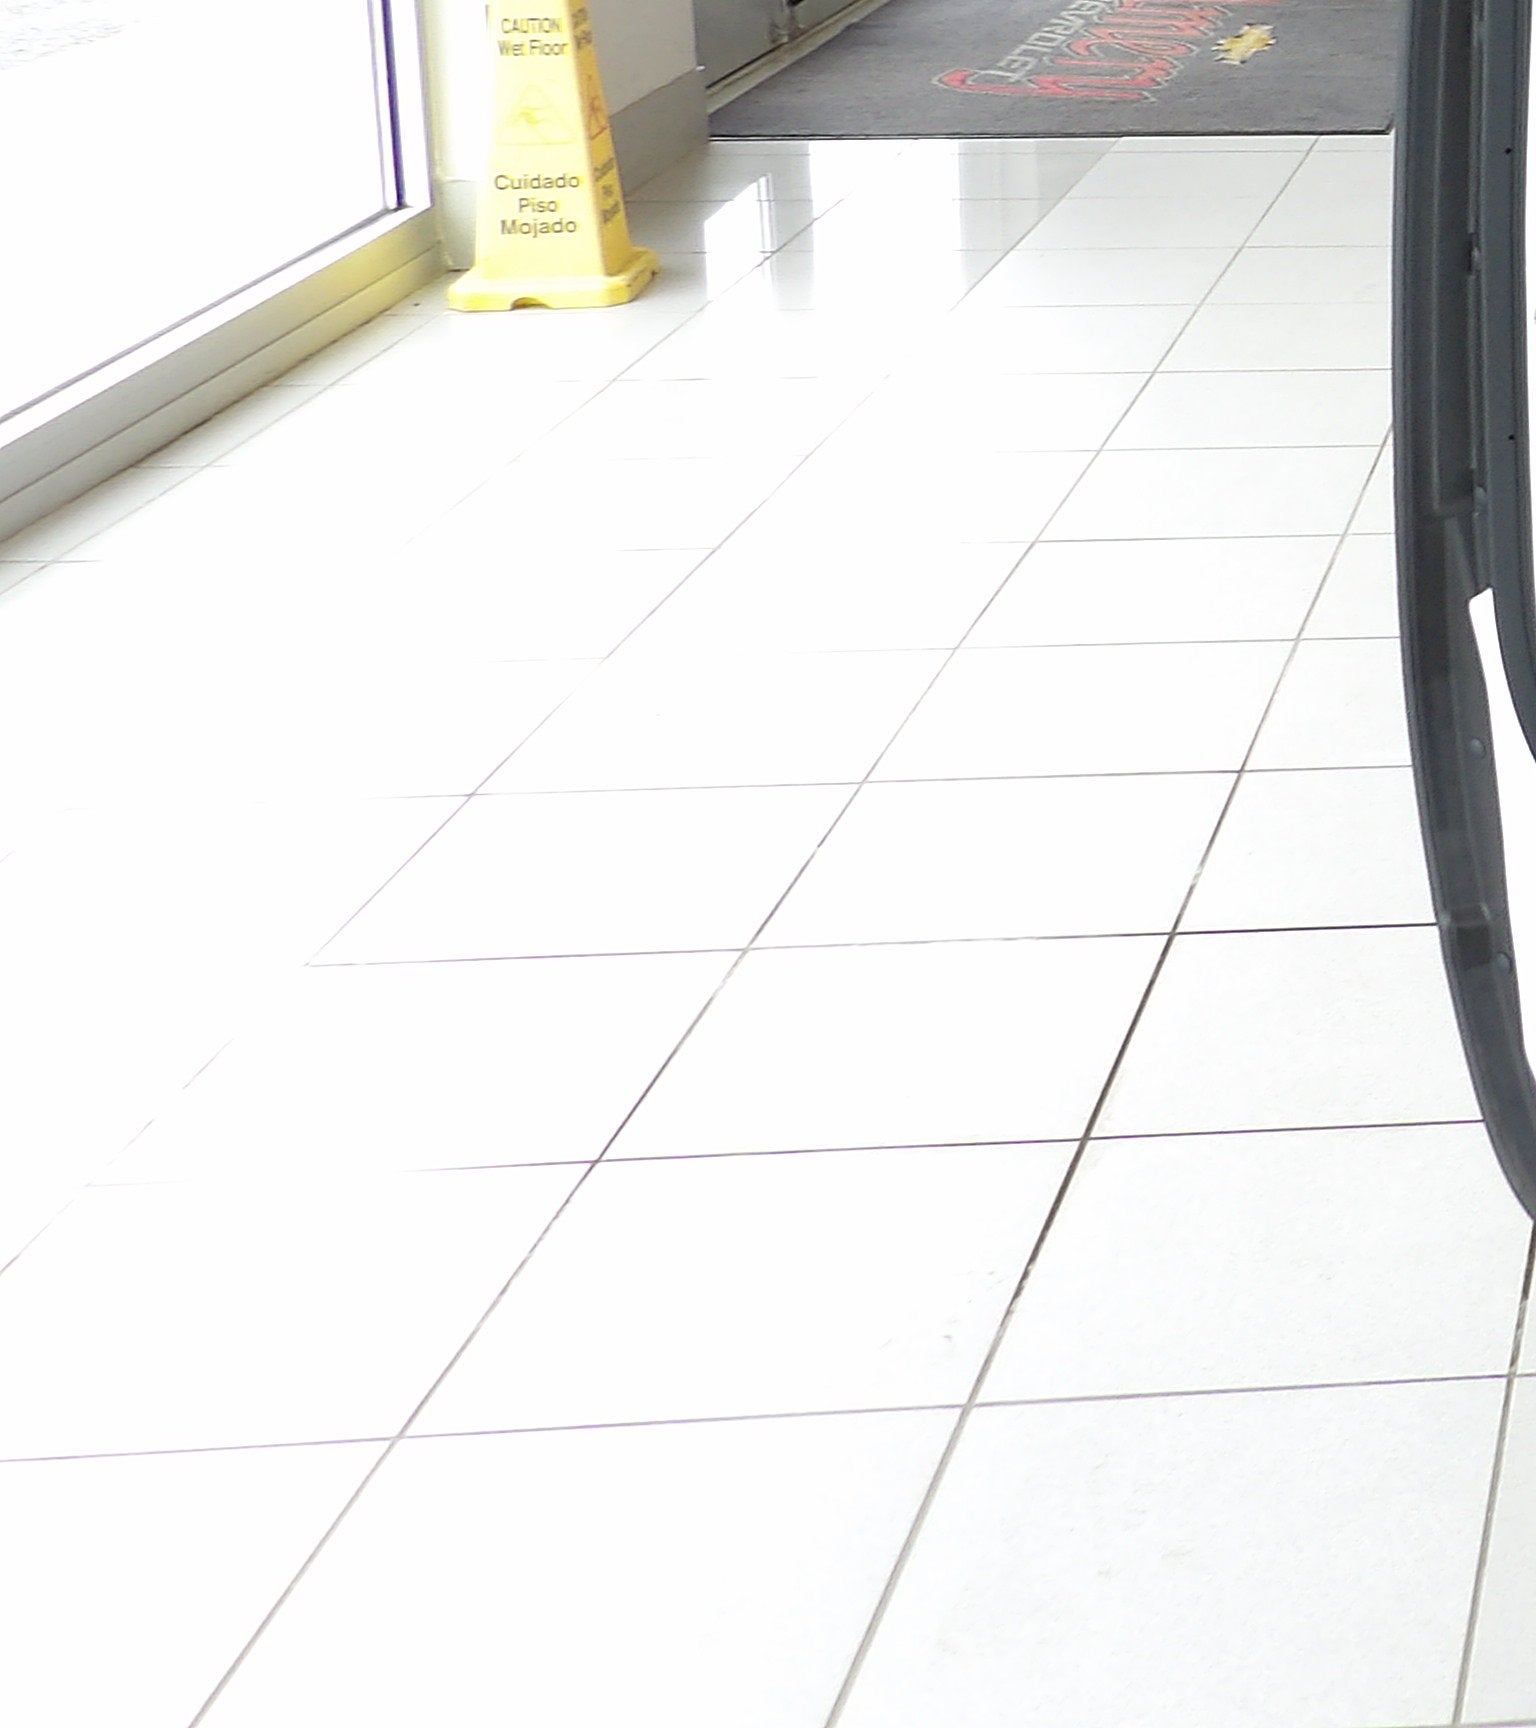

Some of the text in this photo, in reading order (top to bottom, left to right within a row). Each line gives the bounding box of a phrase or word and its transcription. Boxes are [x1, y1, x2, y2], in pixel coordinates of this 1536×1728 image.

[501, 17, 562, 34] CAUTION
[498, 39, 526, 56] Wet
[529, 39, 569, 56] Floor
[494, 174, 580, 190] Cuidado
[518, 197, 558, 213] Piso
[500, 219, 577, 238] Mojado
